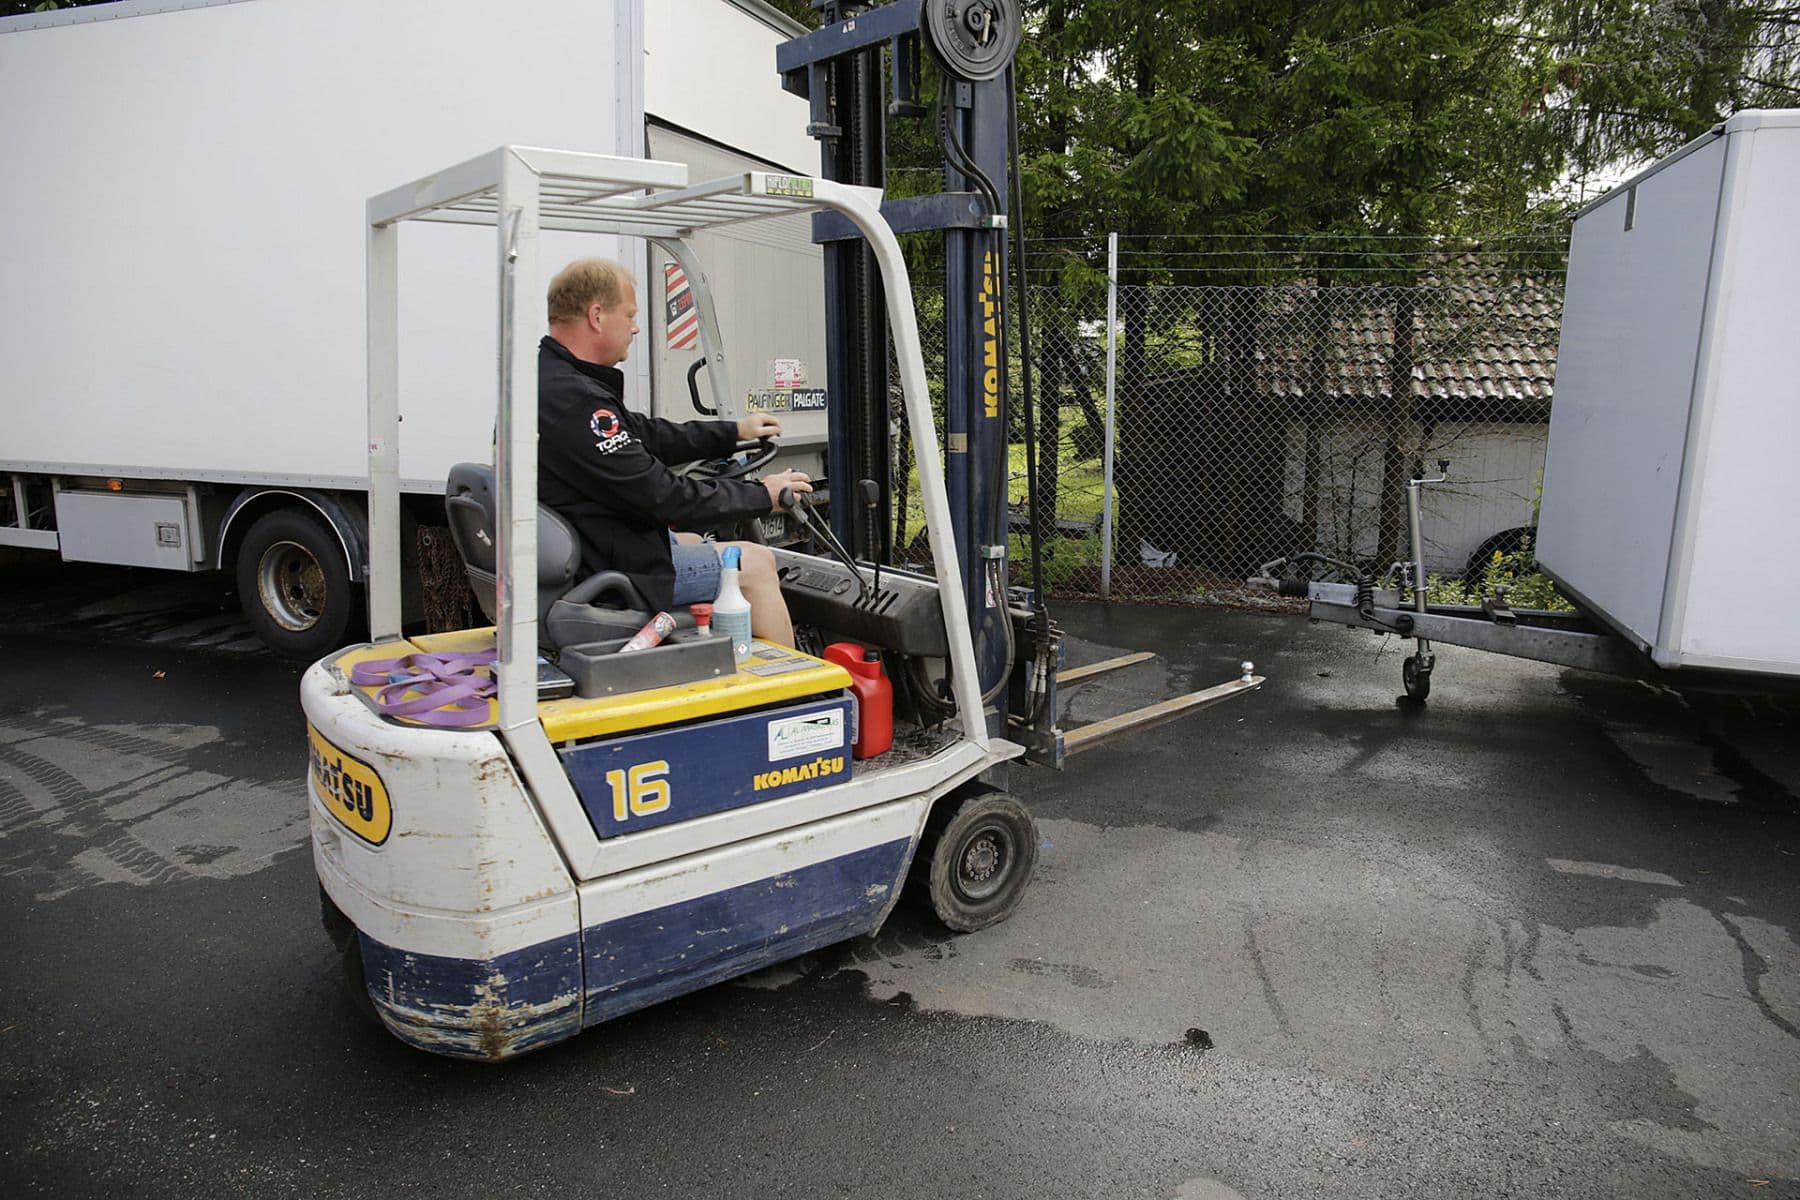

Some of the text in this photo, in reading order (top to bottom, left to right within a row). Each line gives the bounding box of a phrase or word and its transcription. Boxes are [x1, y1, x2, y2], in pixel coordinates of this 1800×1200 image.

[793, 392, 825, 408] PALGATE
[595, 430, 630, 452] TORQ
[753, 757, 844, 791] KOMATSU
[606, 760, 671, 822] 16
